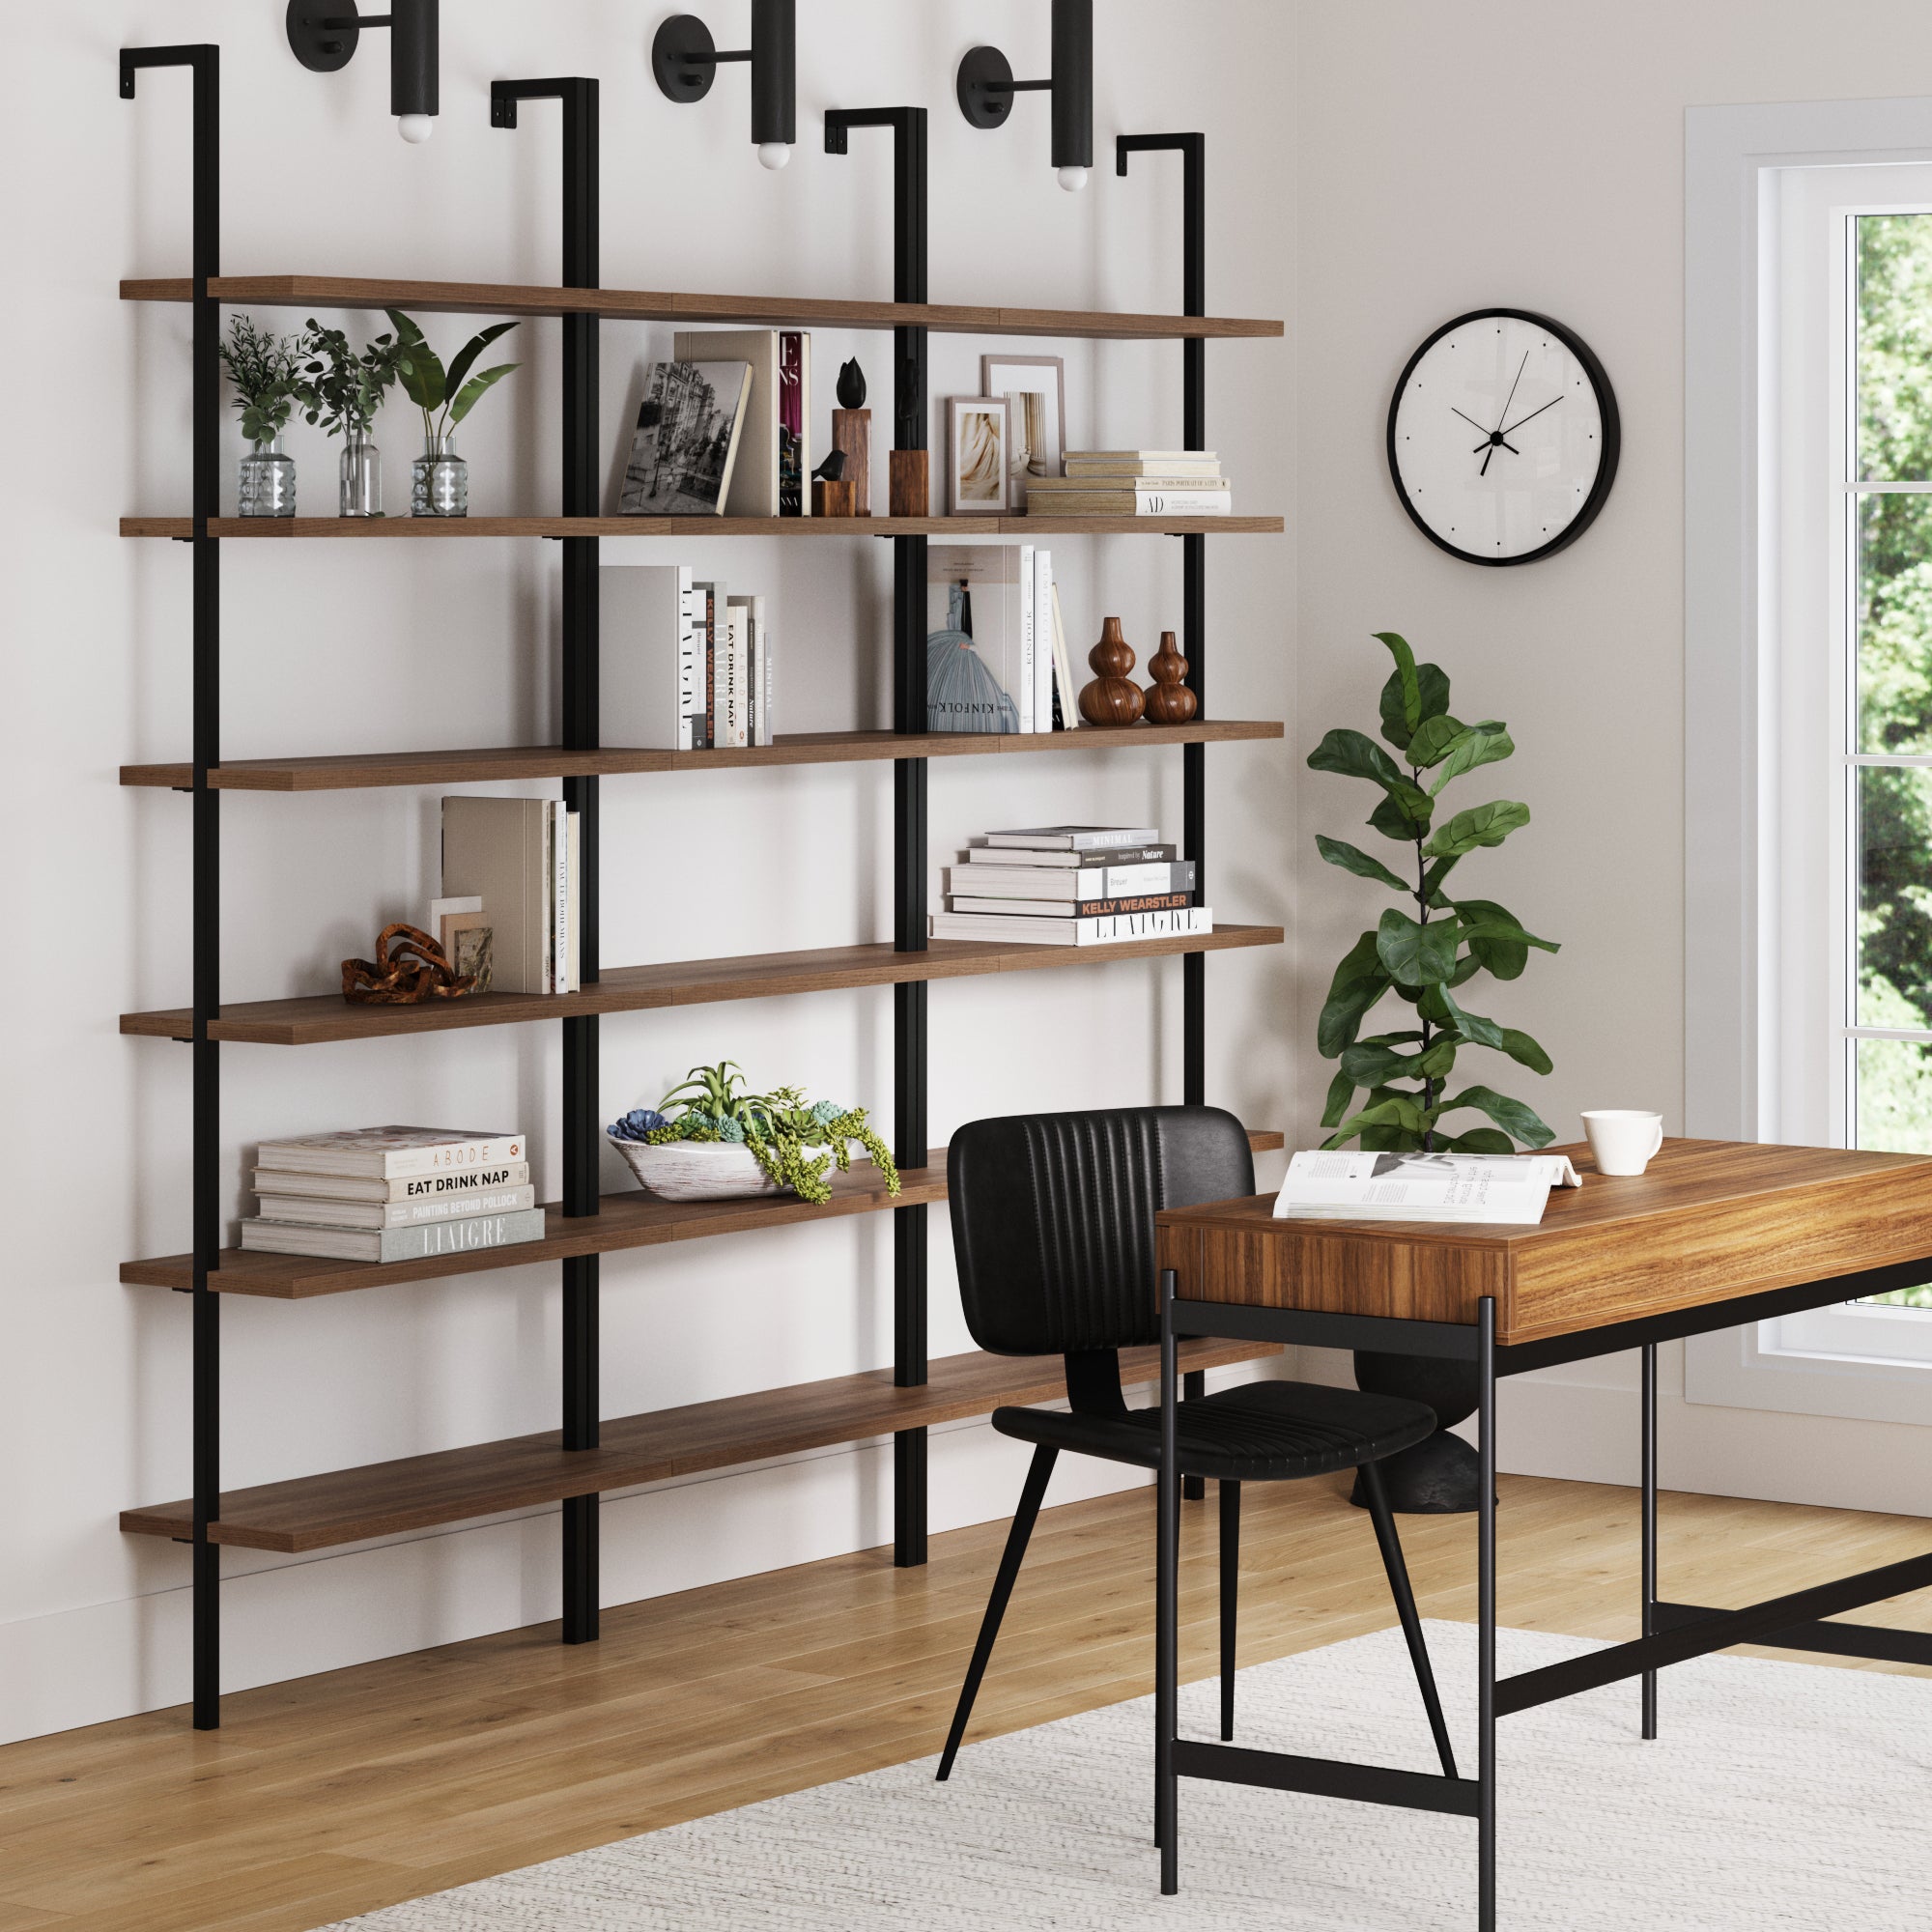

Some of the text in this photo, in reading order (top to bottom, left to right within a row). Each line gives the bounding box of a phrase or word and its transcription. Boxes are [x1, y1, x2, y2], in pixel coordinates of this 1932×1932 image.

[715, 624, 726, 708] LIAIGRE
[939, 701, 995, 714] KINFOLK
[1093, 834, 1133, 846] MINIMAL
[1142, 849, 1164, 860] Nature
[1082, 895, 1187, 915] KELLY WEARSTLER
[433, 1146, 490, 1168] ABODE
[408, 1180, 432, 1196] EAT
[436, 1175, 478, 1192] DRINK
[481, 1170, 509, 1185] NAP
[412, 1203, 448, 1219] PAINTING
[450, 1198, 481, 1213] BEYOND
[483, 1193, 518, 1209] POLLOCK
[423, 1217, 507, 1255] LIAIGRE
